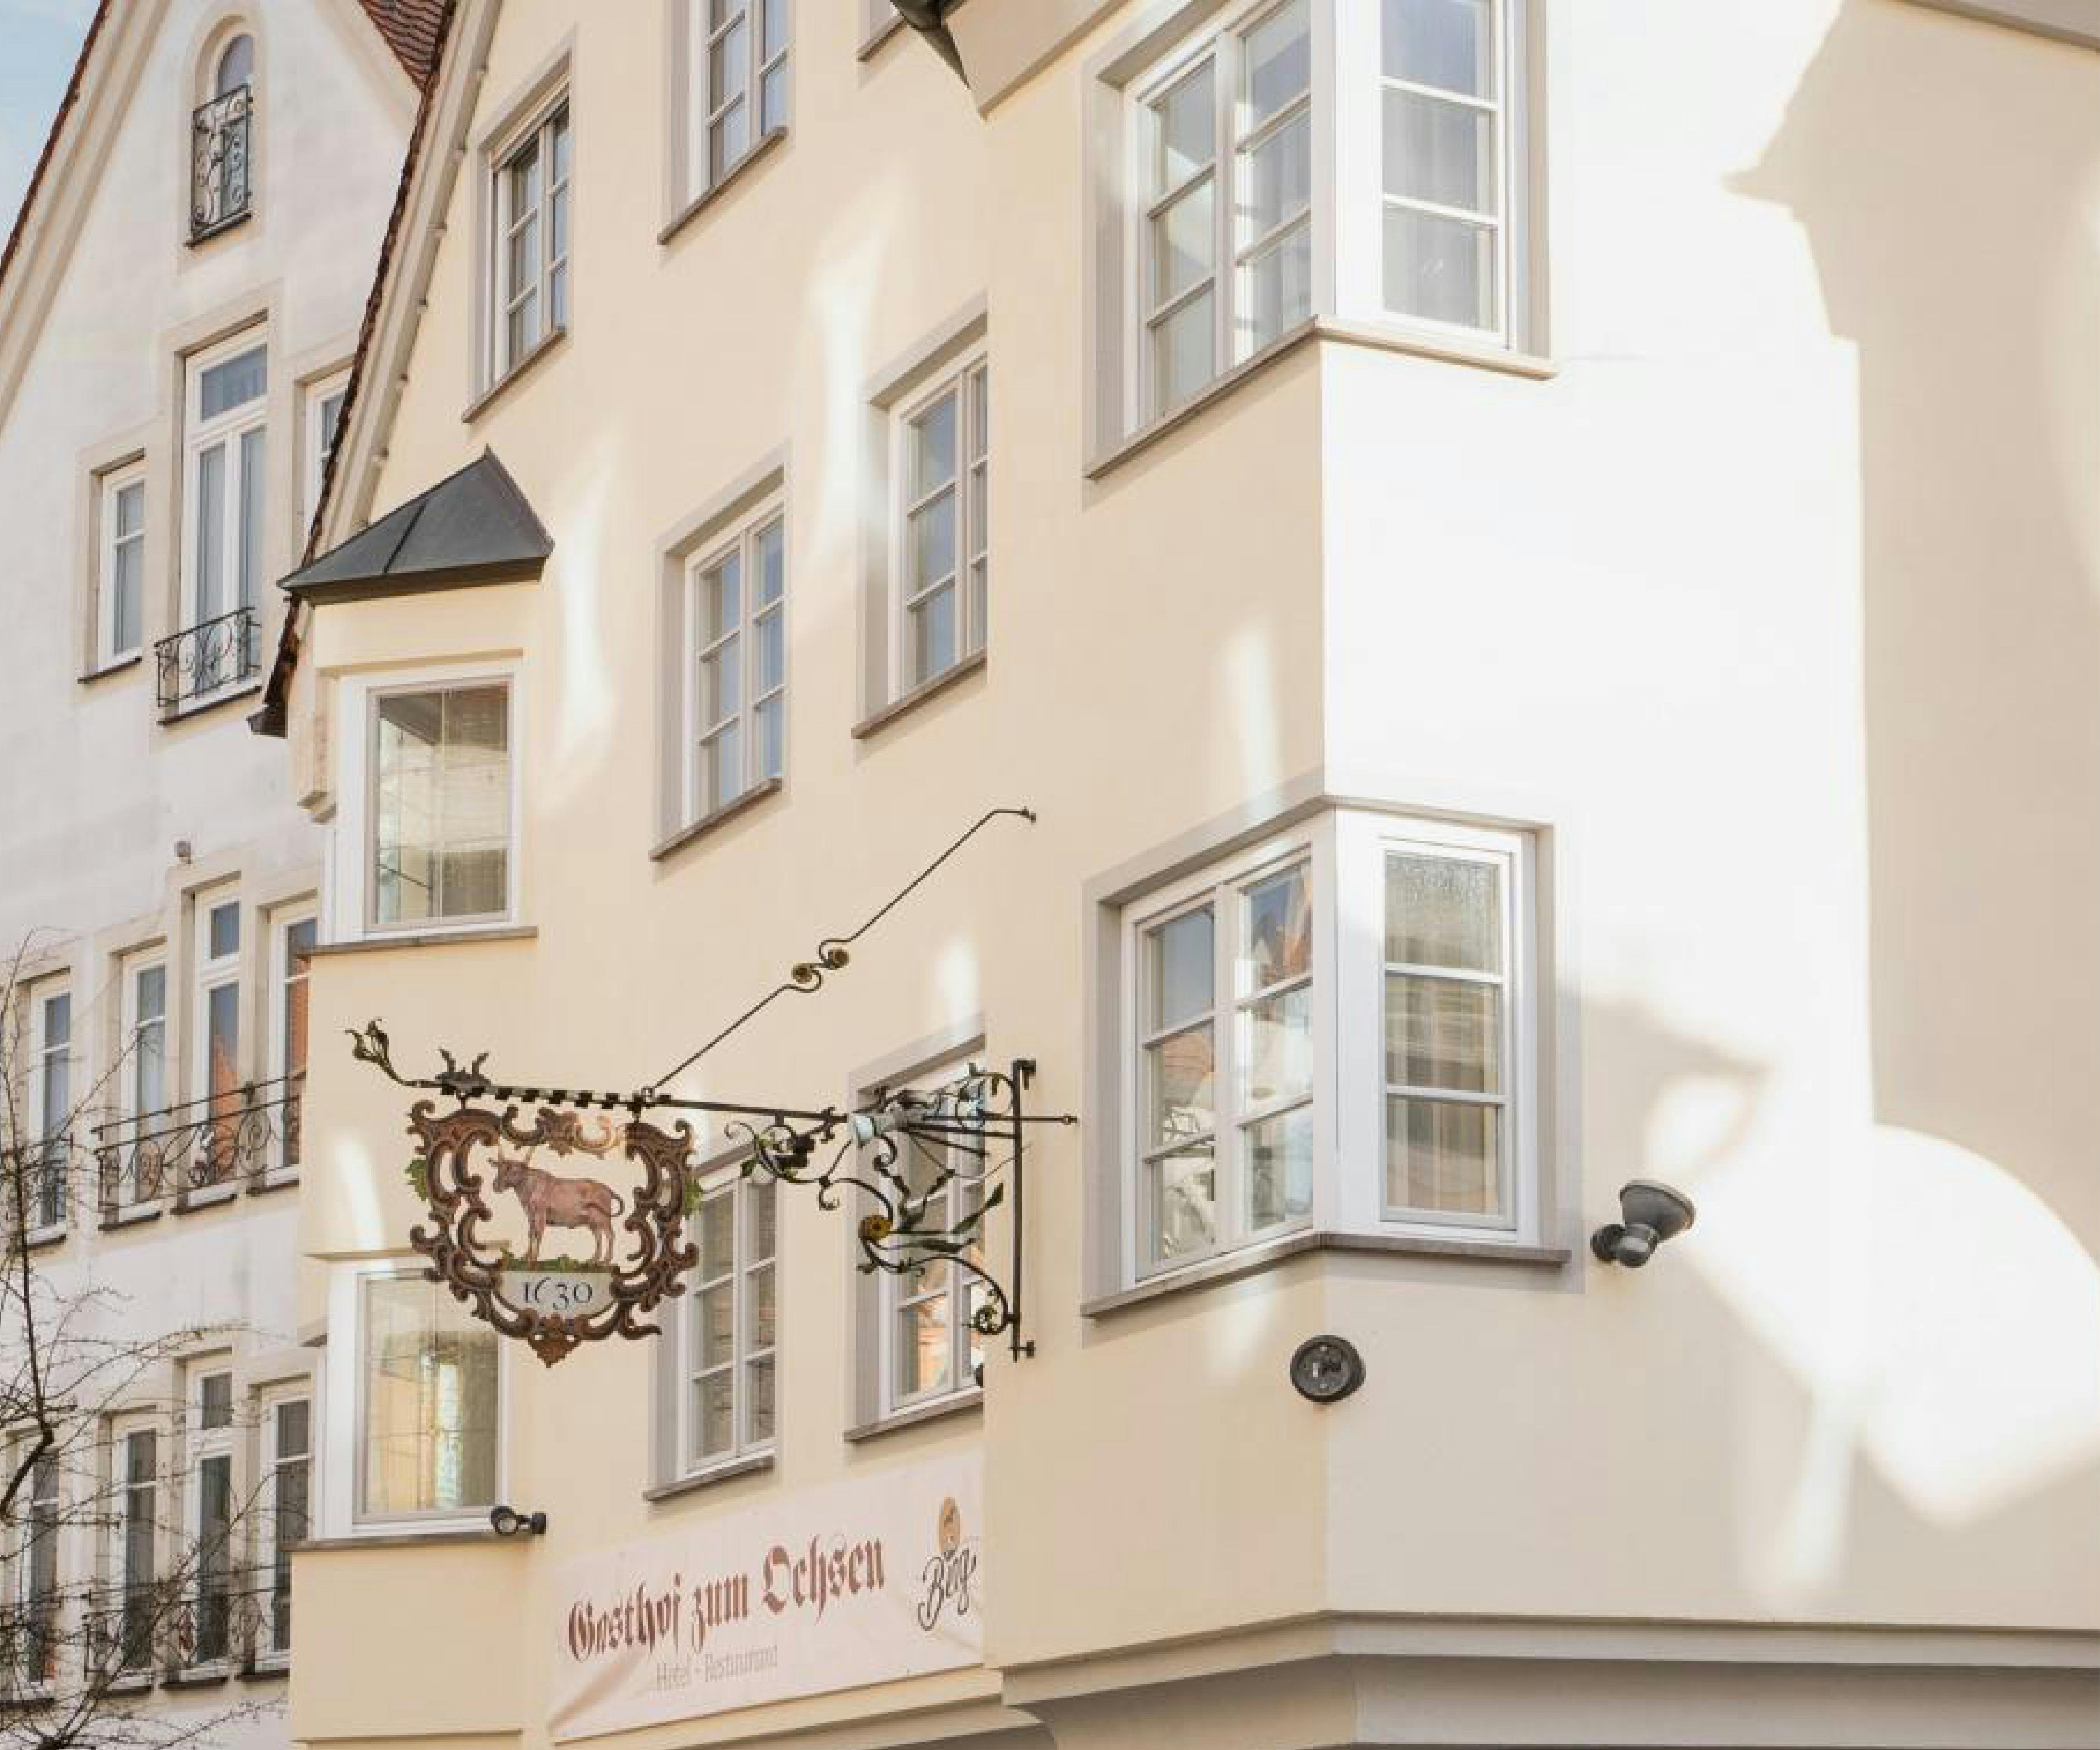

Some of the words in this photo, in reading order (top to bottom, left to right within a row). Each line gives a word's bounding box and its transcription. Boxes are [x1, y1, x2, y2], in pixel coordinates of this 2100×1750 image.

[523, 1277, 593, 1310] 1630
[569, 1572, 682, 1661] Gasthof
[691, 1570, 748, 1653] zum
[763, 1535, 885, 1625] Ochsen
[657, 1653, 692, 1691] Hotel
